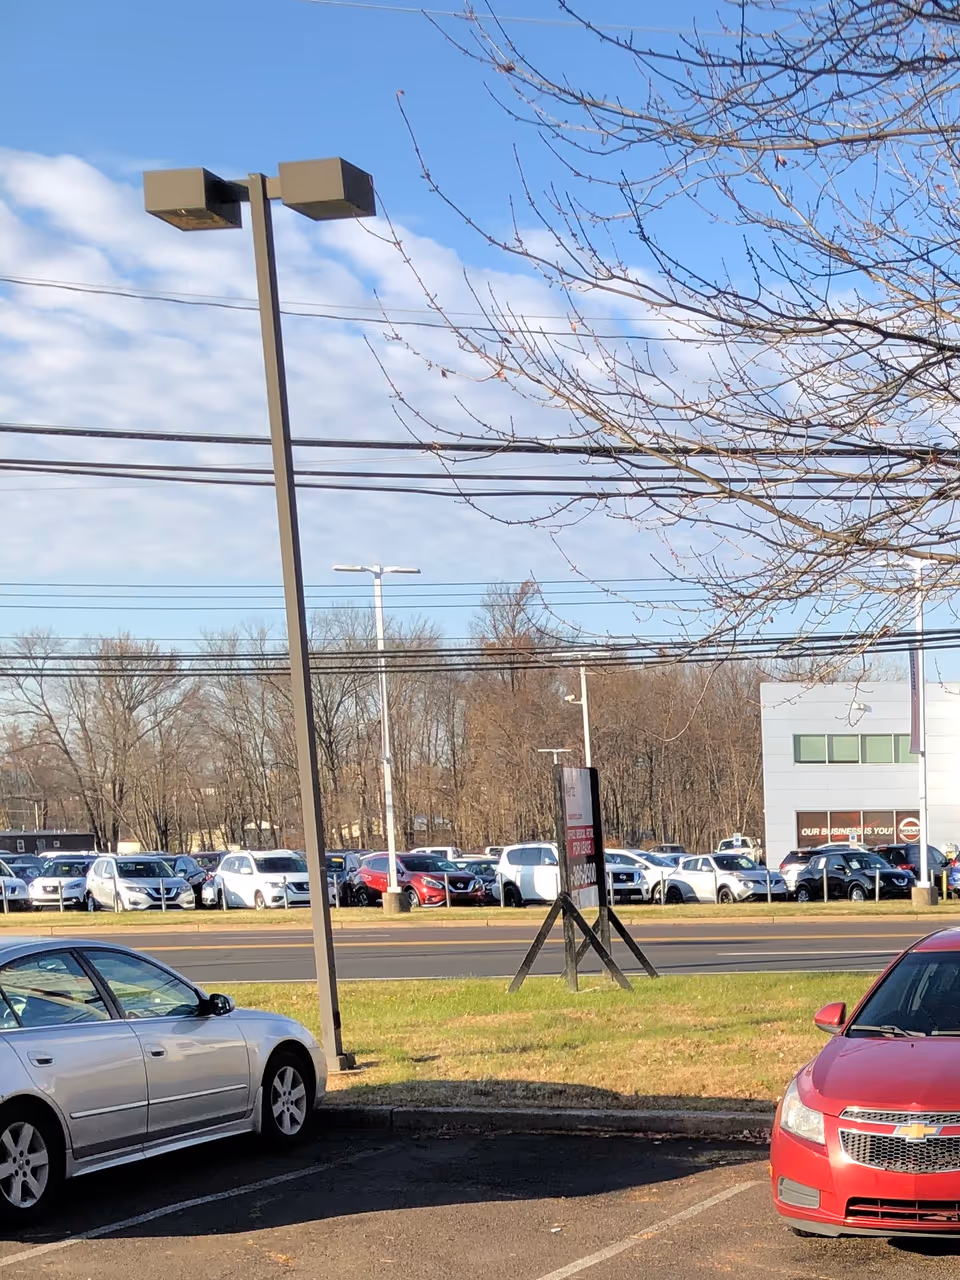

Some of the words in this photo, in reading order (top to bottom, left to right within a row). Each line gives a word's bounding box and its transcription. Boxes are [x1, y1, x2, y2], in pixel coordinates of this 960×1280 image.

[801, 828, 820, 836] OUR
[821, 827, 862, 836] BUSINESS
[864, 827, 872, 835] IS
[874, 827, 894, 835] YOU!
